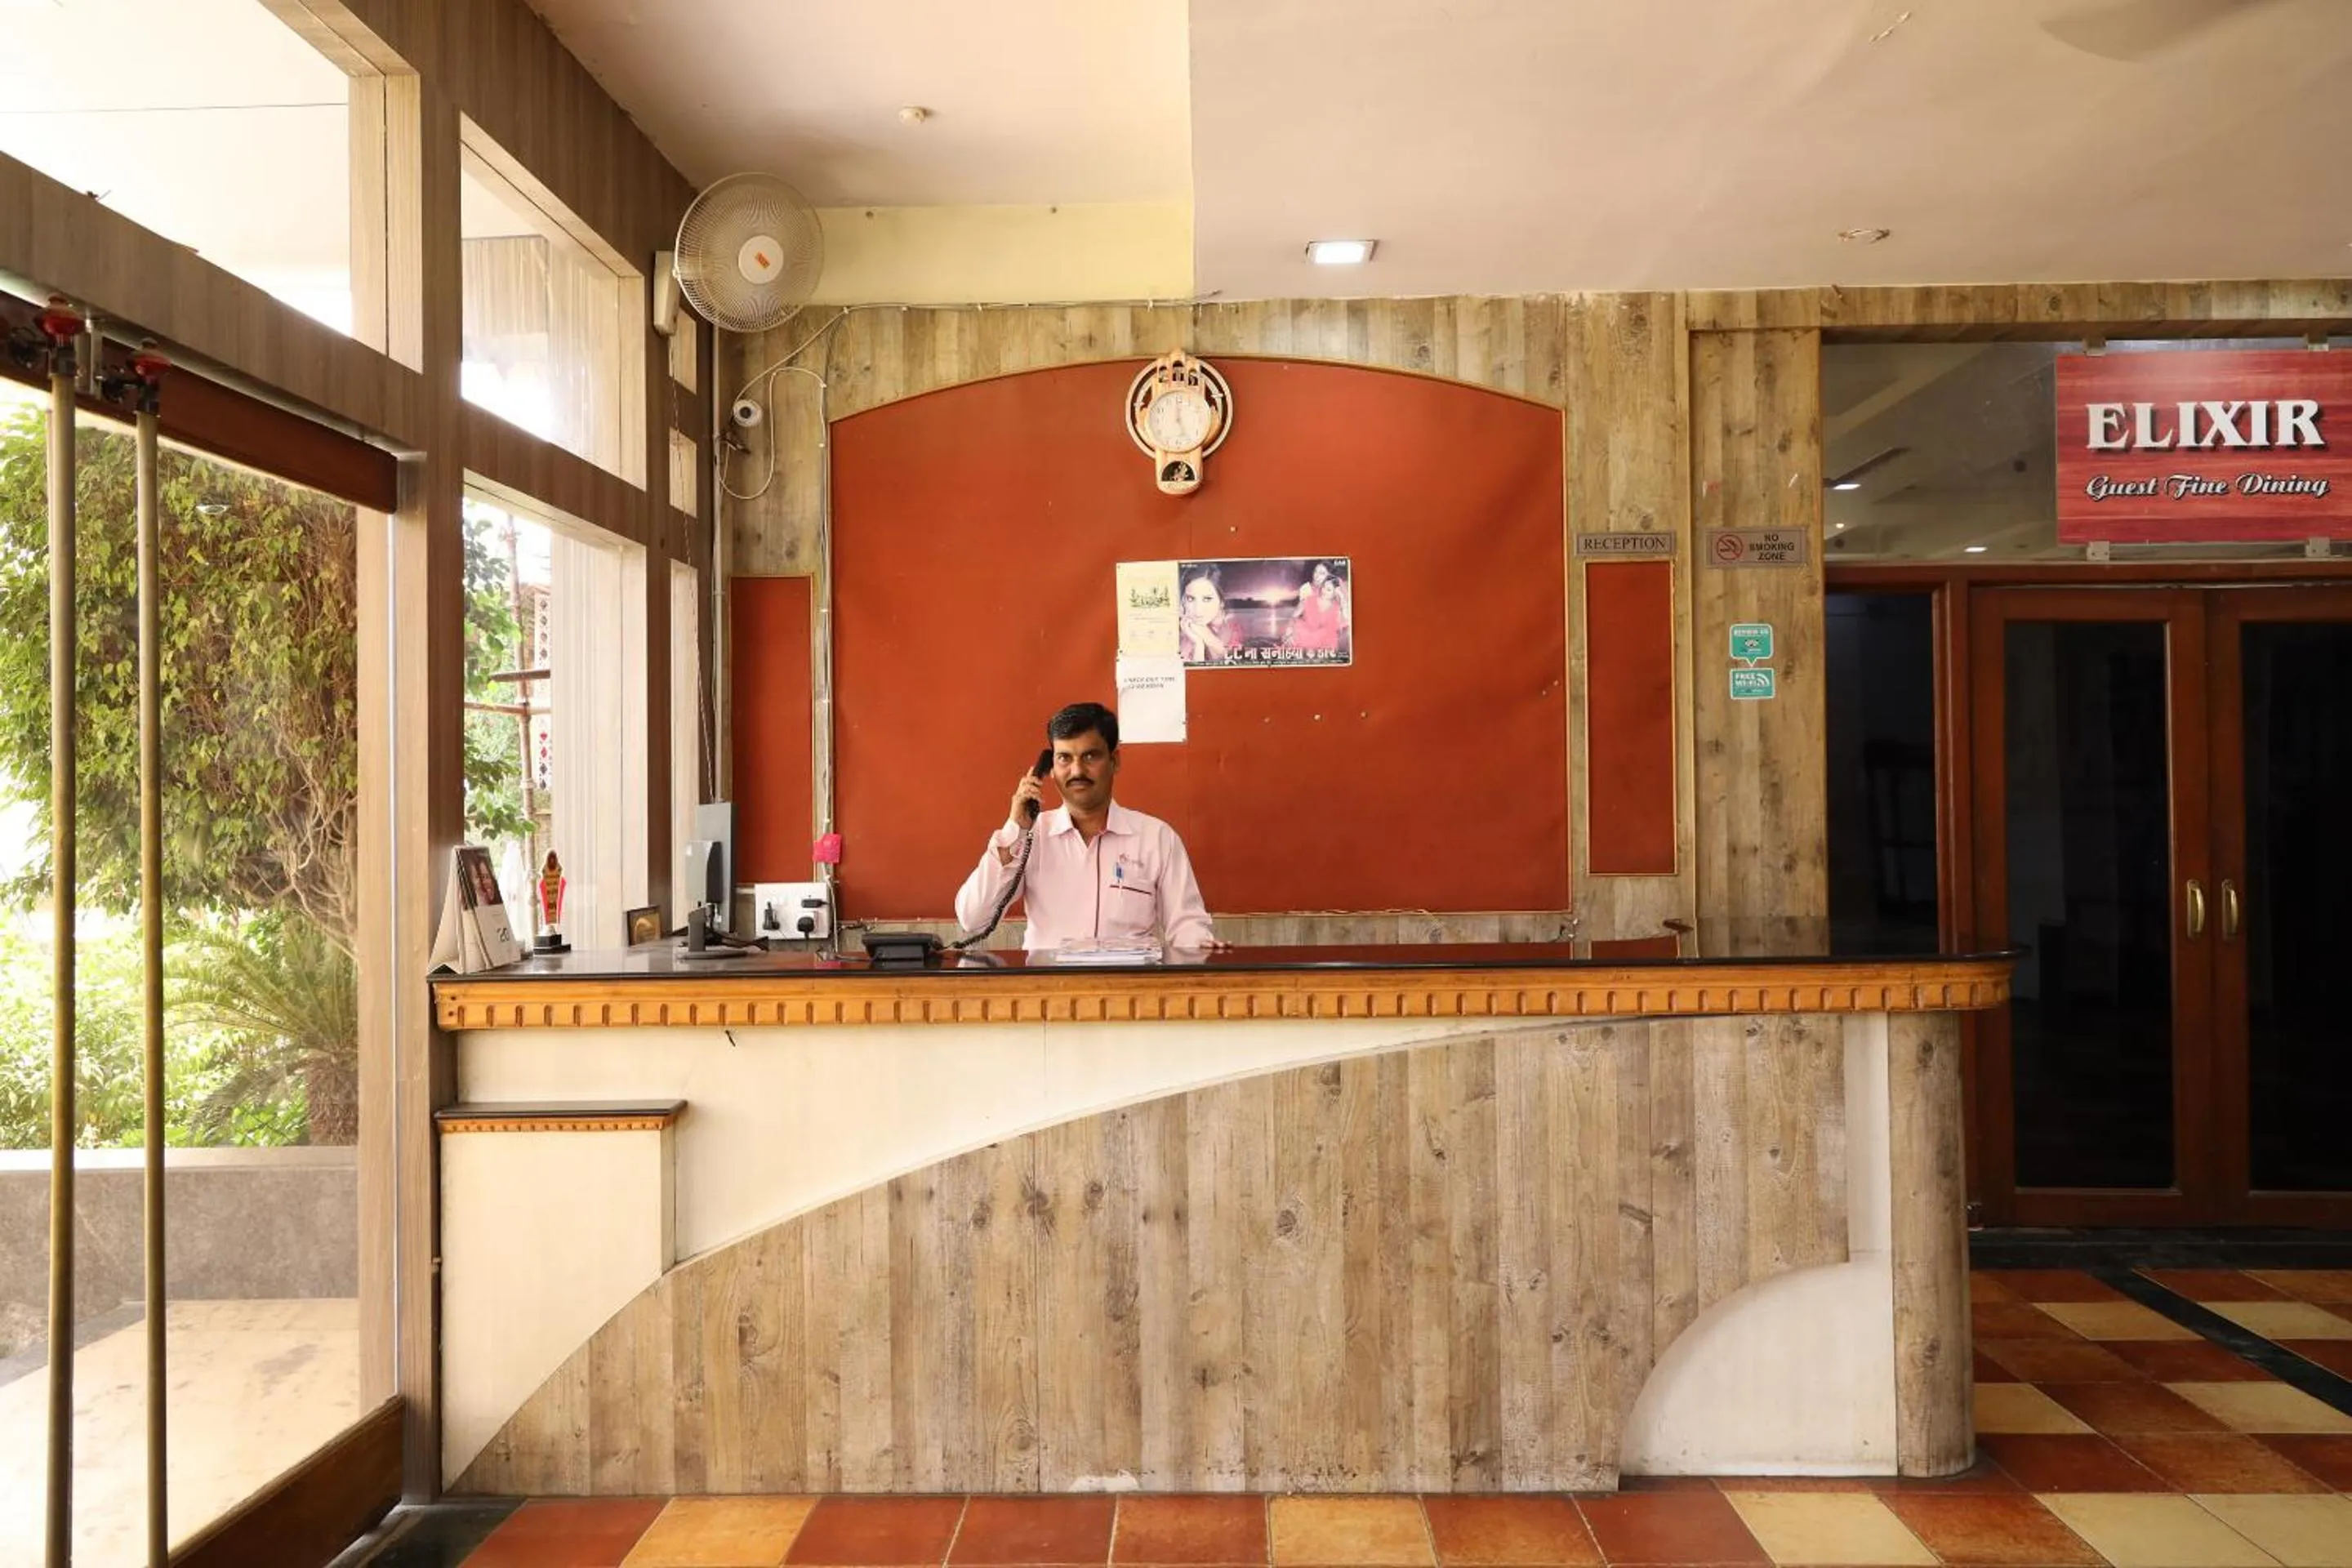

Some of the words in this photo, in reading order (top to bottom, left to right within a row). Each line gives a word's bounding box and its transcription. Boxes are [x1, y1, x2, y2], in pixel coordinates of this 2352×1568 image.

[2085, 399, 2327, 451] ELIXIR
[2085, 474, 2159, 501] Guest
[2165, 474, 2230, 500] Fine
[2235, 473, 2330, 497] Dining
[1763, 533, 1780, 542] NO
[1584, 537, 1668, 550] RECEPTION
[1748, 542, 1795, 552] SMOKING
[1757, 552, 1786, 561] ZONE
